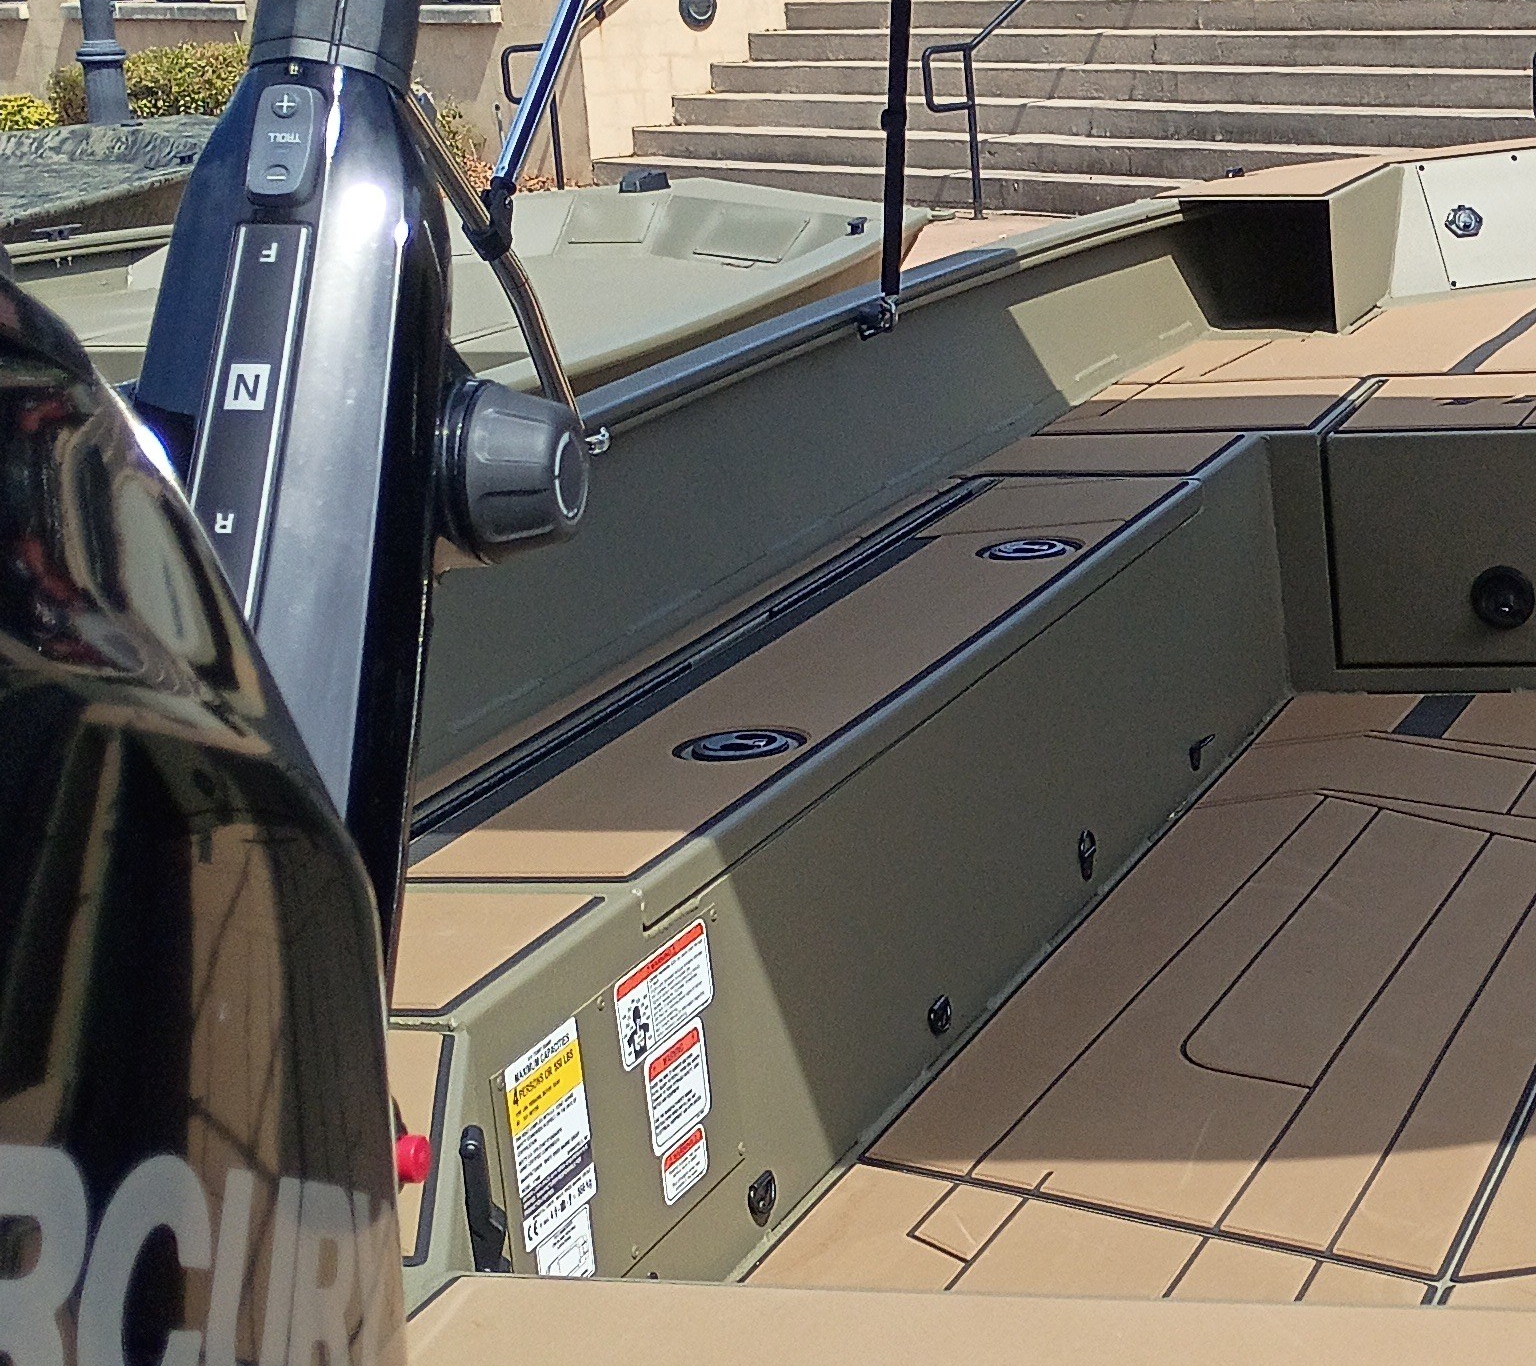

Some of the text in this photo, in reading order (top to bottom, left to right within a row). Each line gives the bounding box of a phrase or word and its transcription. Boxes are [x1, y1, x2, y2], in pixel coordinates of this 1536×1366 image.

[267, 131, 301, 144] TROLL
[259, 242, 279, 264] F
[233, 373, 261, 402] N
[215, 512, 235, 534] R
[513, 1086, 520, 1106] 4
